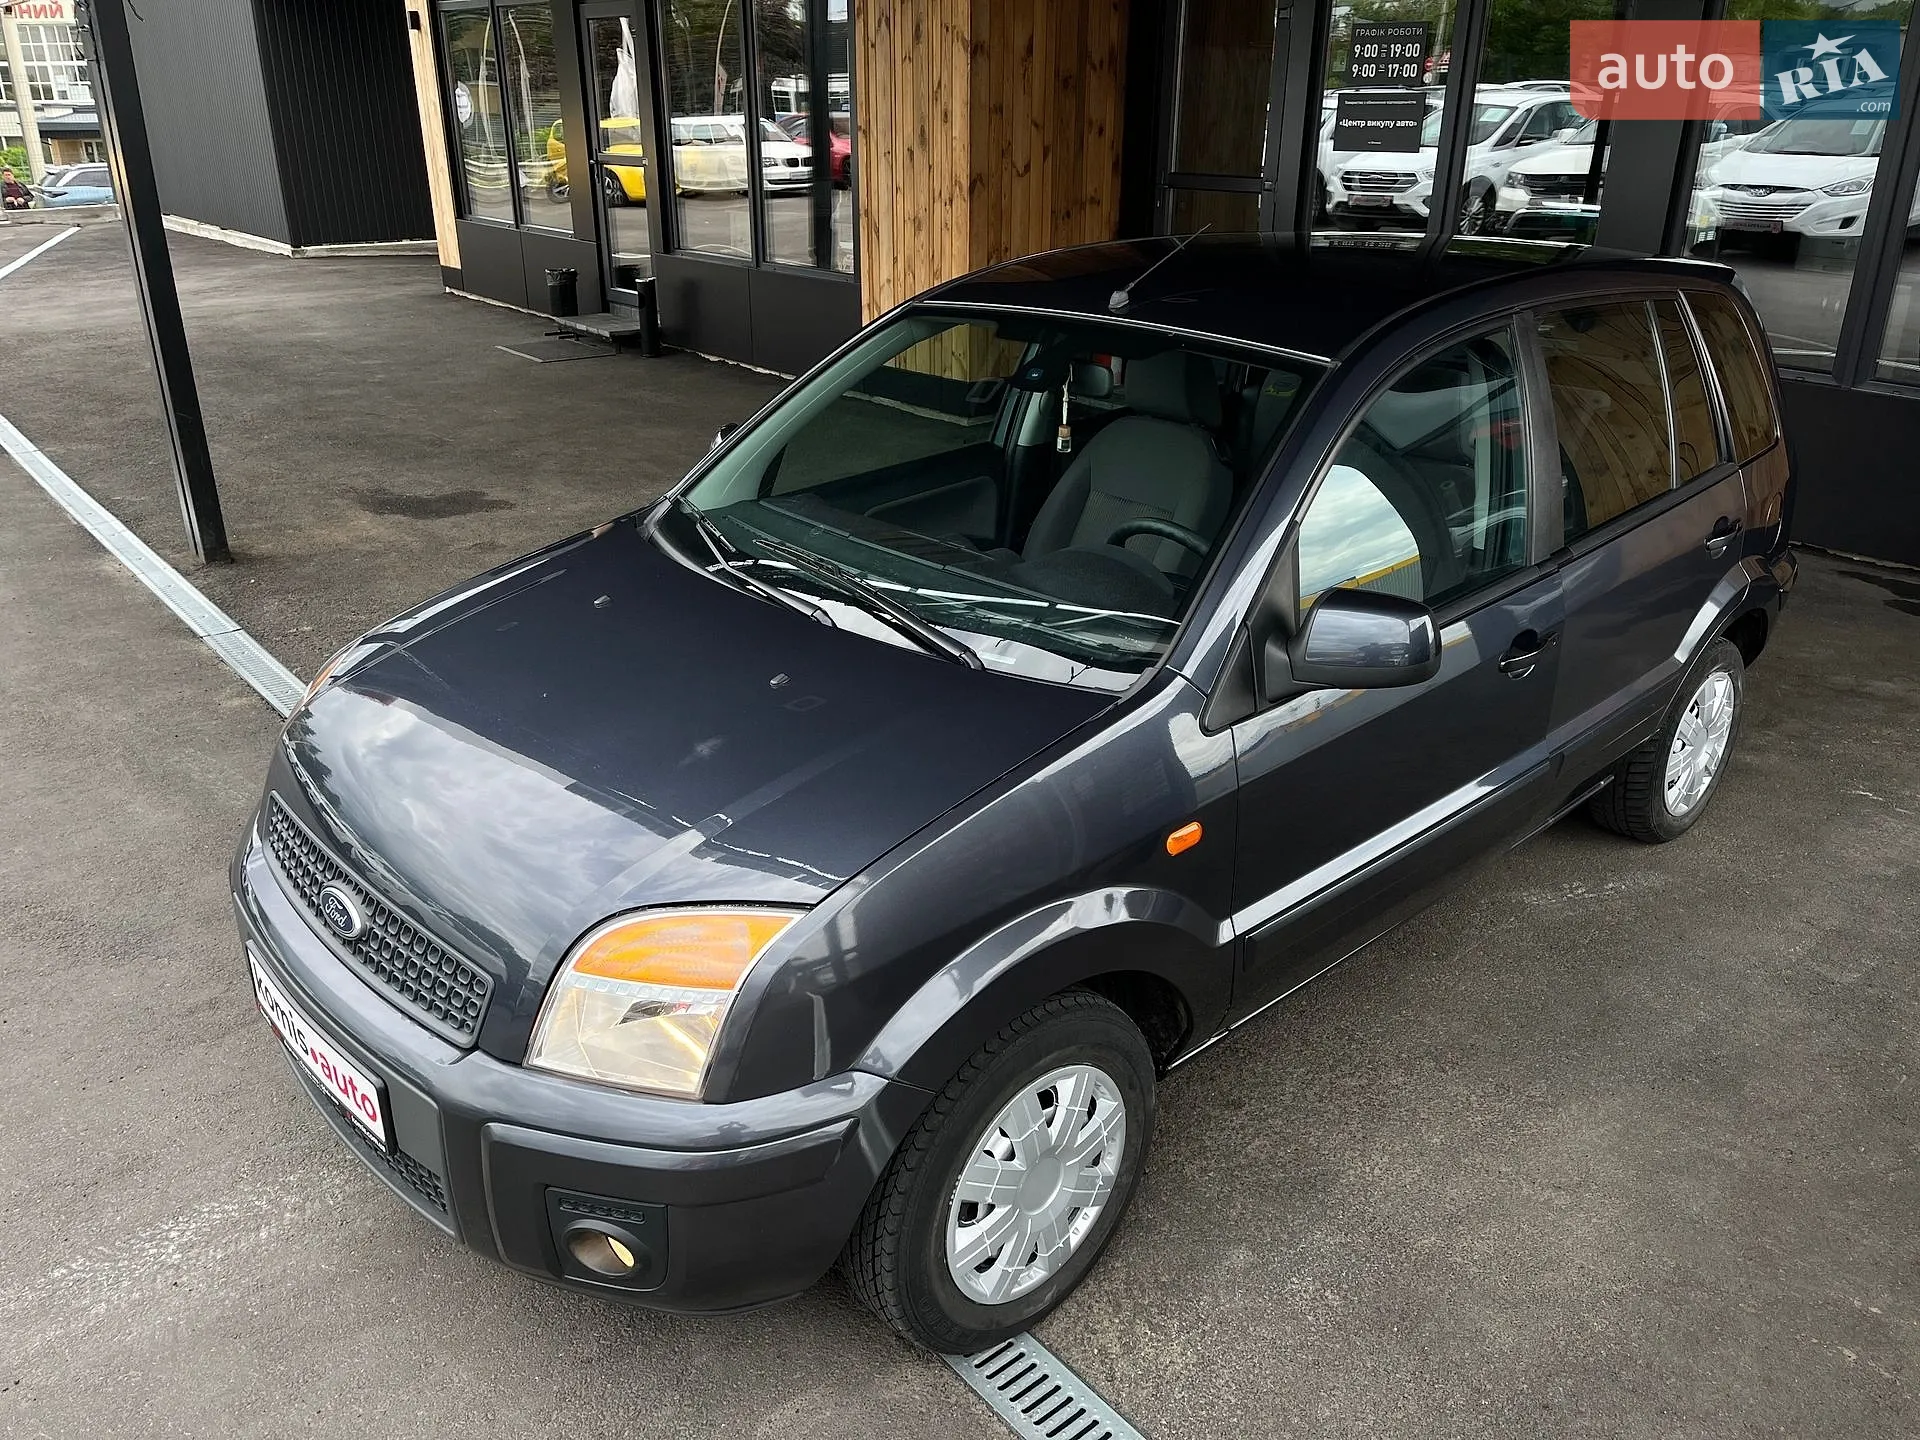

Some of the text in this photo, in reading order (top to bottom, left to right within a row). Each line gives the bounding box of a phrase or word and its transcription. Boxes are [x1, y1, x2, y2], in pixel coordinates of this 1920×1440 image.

[15, 0, 64, 18] НИЙ
[1355, 27, 1423, 37] ГРАФІК РОБОТИ
[1354, 43, 1420, 58] 9:00 19:00
[1352, 64, 1418, 77] 9:00 17:00
[325, 896, 348, 928] Ford
